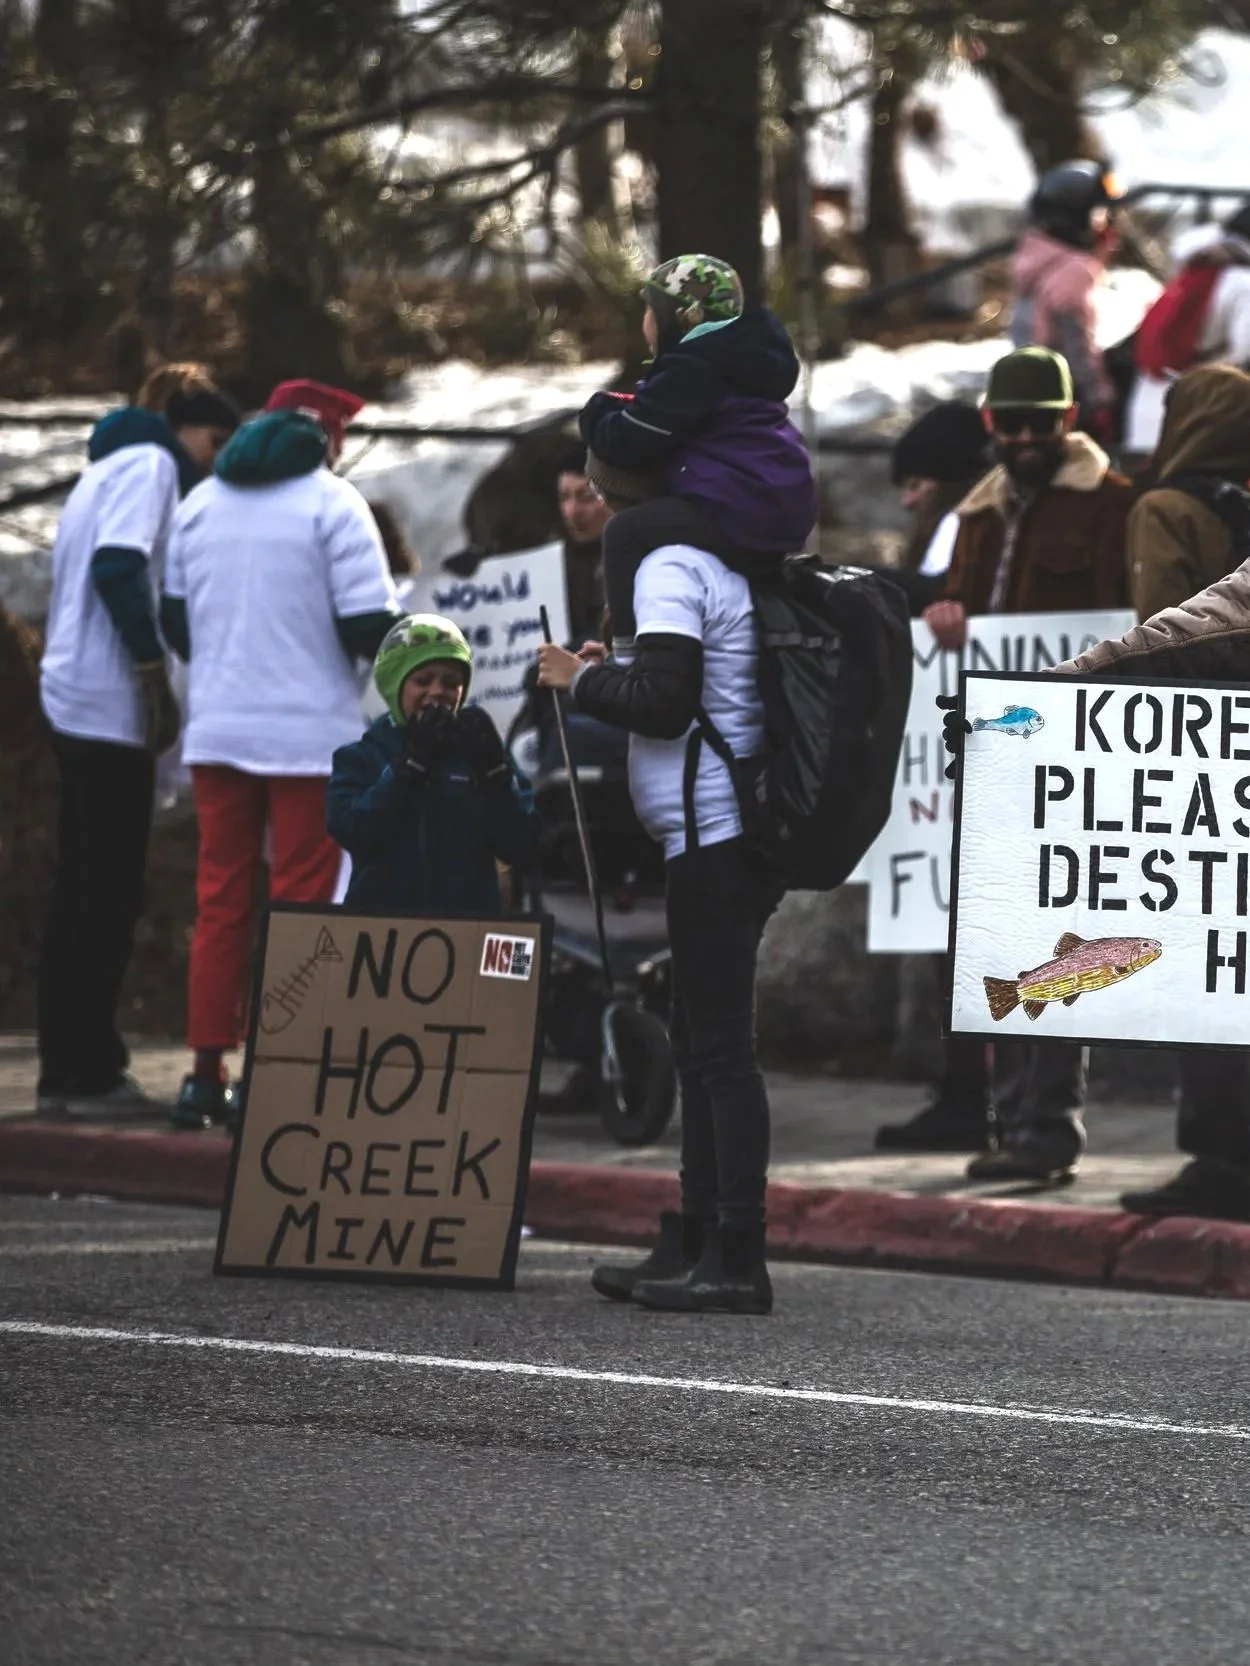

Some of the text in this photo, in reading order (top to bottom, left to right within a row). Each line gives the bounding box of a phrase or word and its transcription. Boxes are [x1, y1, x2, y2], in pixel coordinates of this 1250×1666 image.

[347, 927, 455, 1005] NO
[314, 1023, 486, 1119] HOT
[260, 1122, 502, 1200] CREEK
[265, 1201, 466, 1268] MINE
